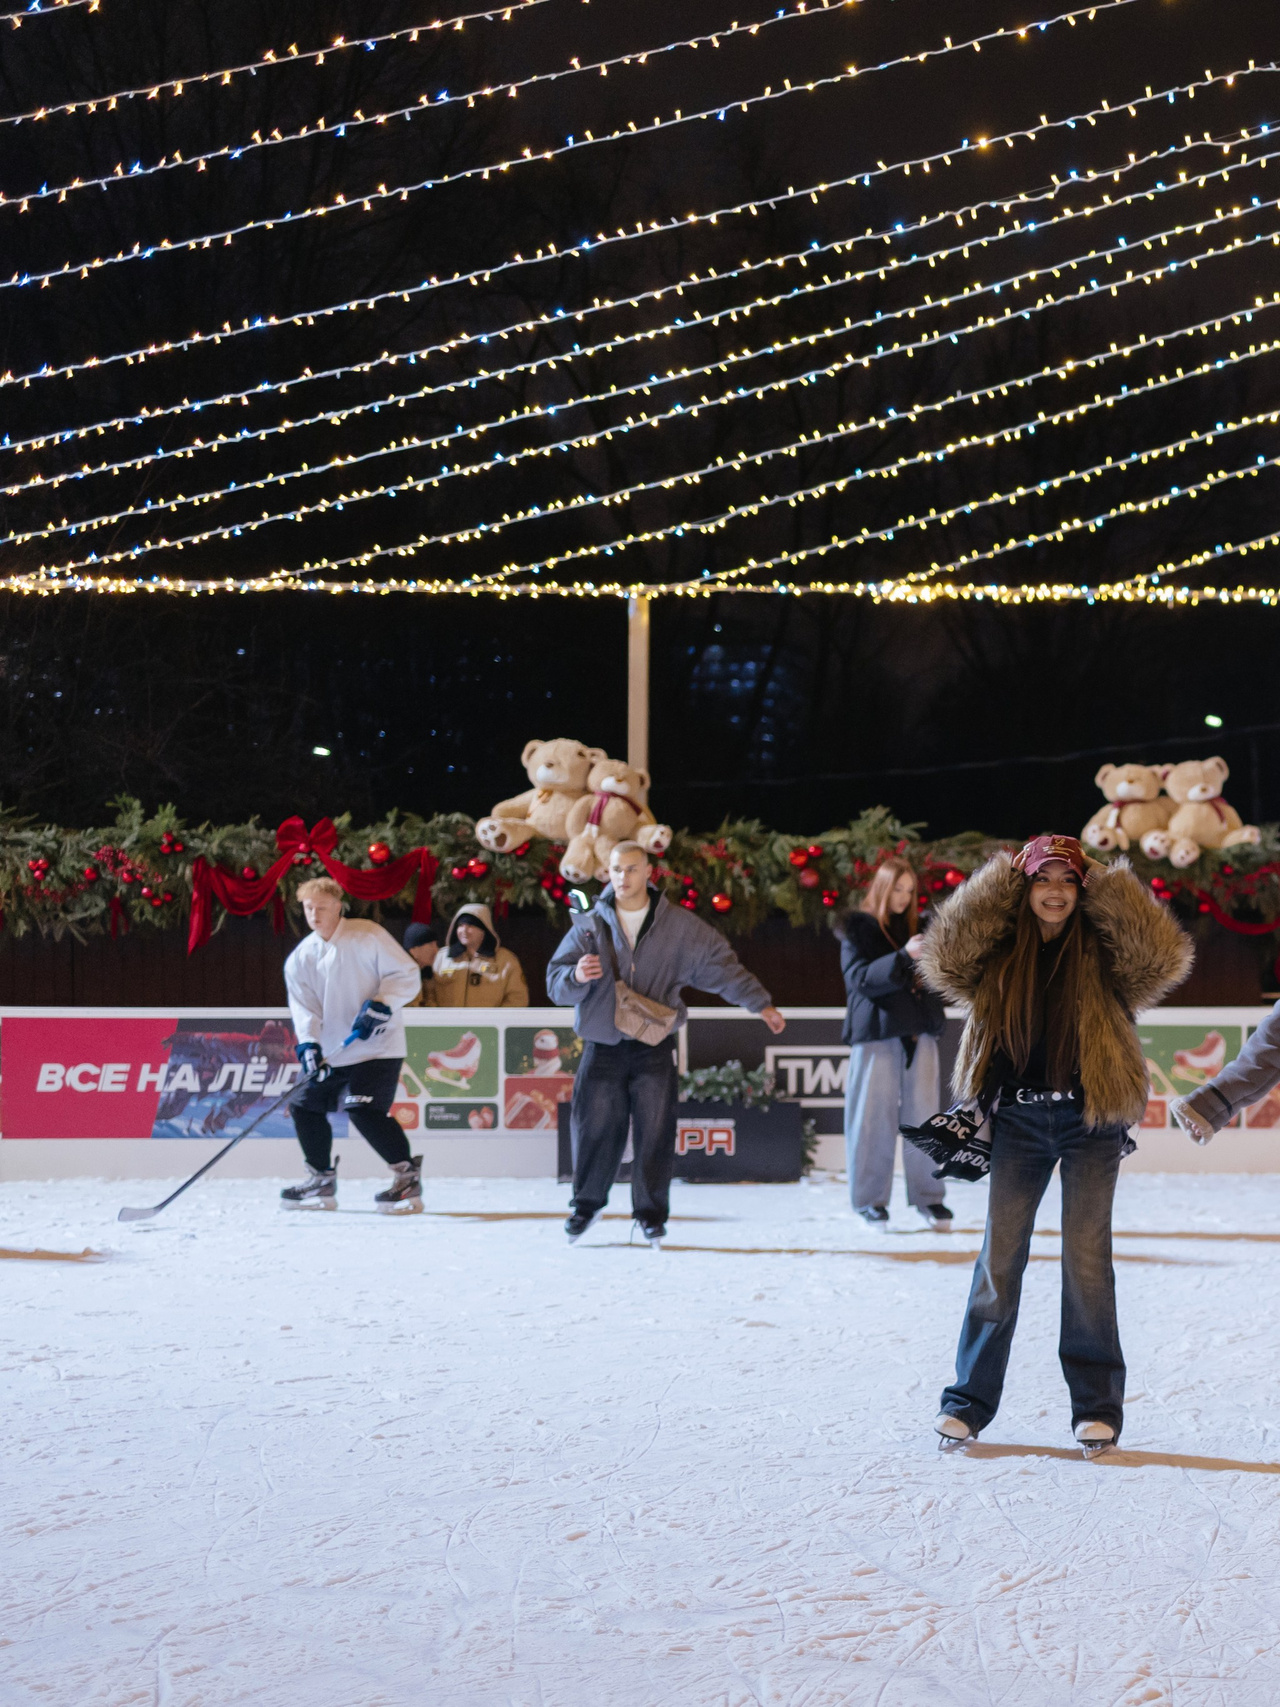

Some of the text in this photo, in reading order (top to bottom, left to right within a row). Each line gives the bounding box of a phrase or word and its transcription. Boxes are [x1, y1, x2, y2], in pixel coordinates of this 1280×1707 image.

[36, 1056, 303, 1097] ВСЕ НА ЛЁД
[778, 1058, 850, 1095] ТИМ
